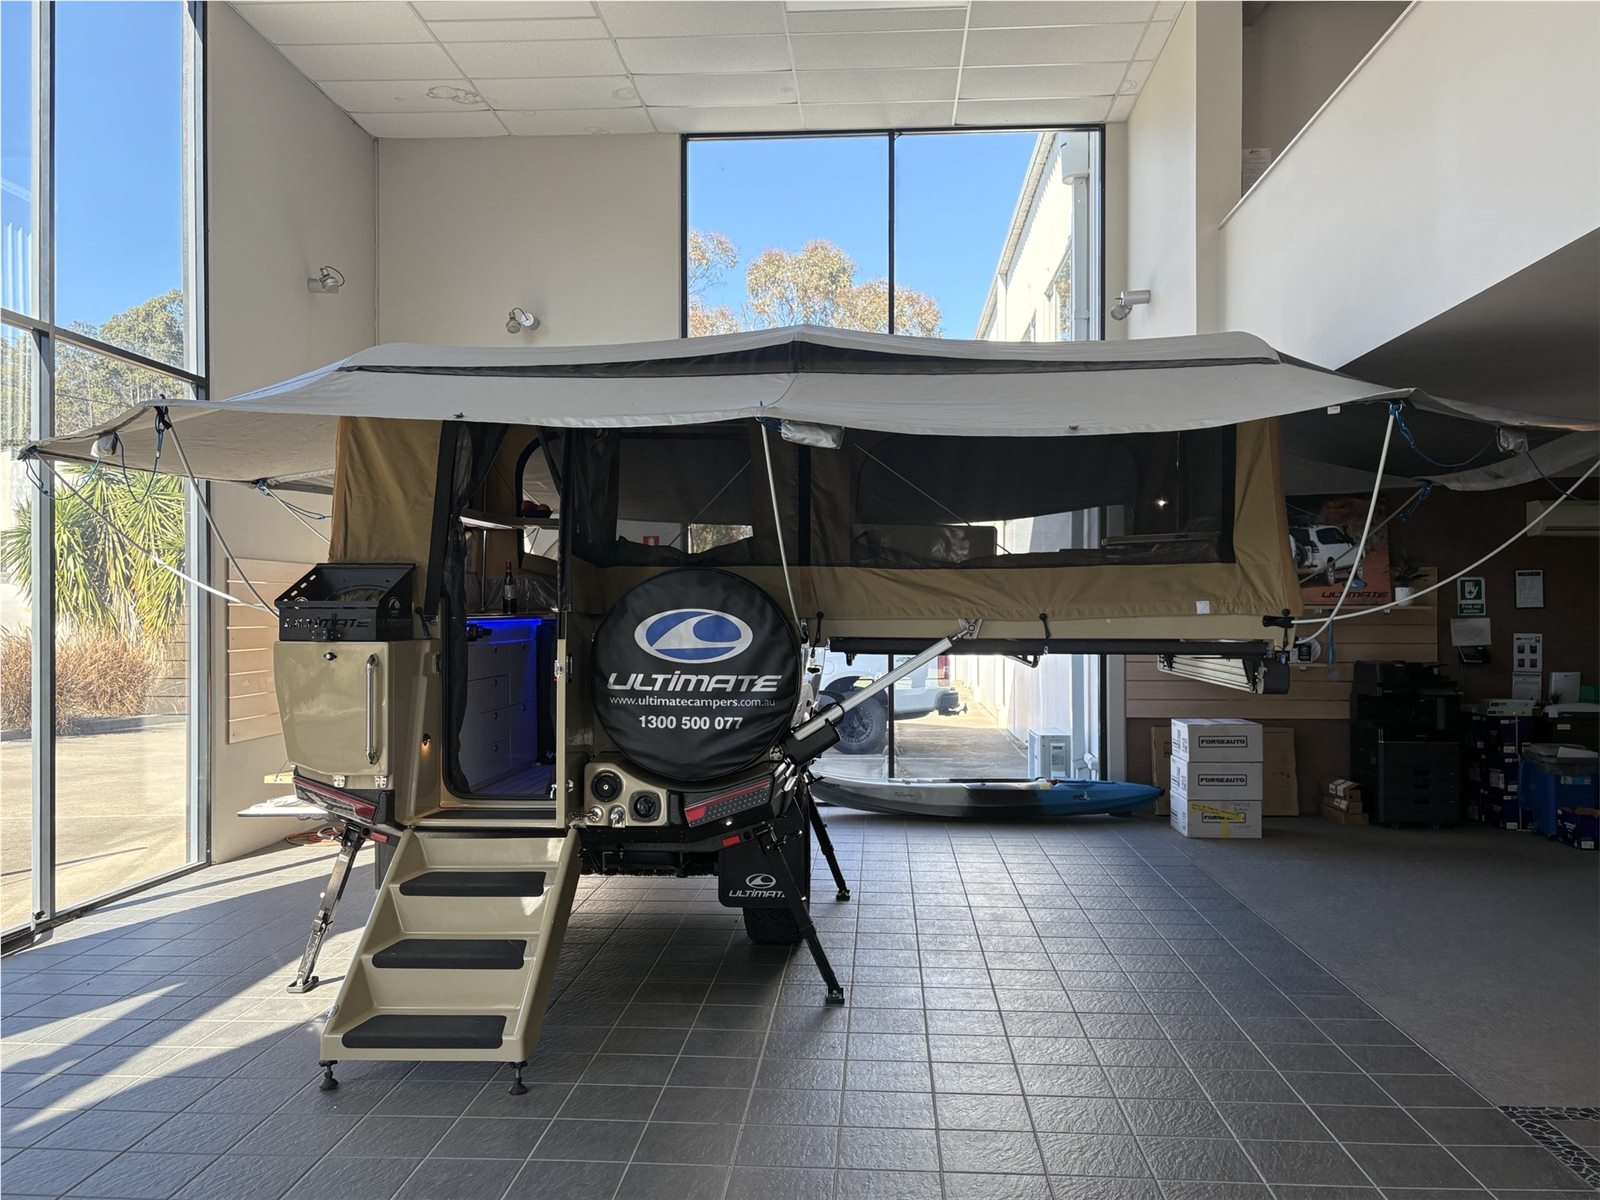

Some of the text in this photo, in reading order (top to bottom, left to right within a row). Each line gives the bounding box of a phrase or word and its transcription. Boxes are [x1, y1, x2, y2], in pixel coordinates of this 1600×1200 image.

[609, 695, 776, 709] www.ultimatecampers.com.au
[638, 715, 743, 730] 1300 500 077
[728, 889, 785, 898] ULTIMAT
